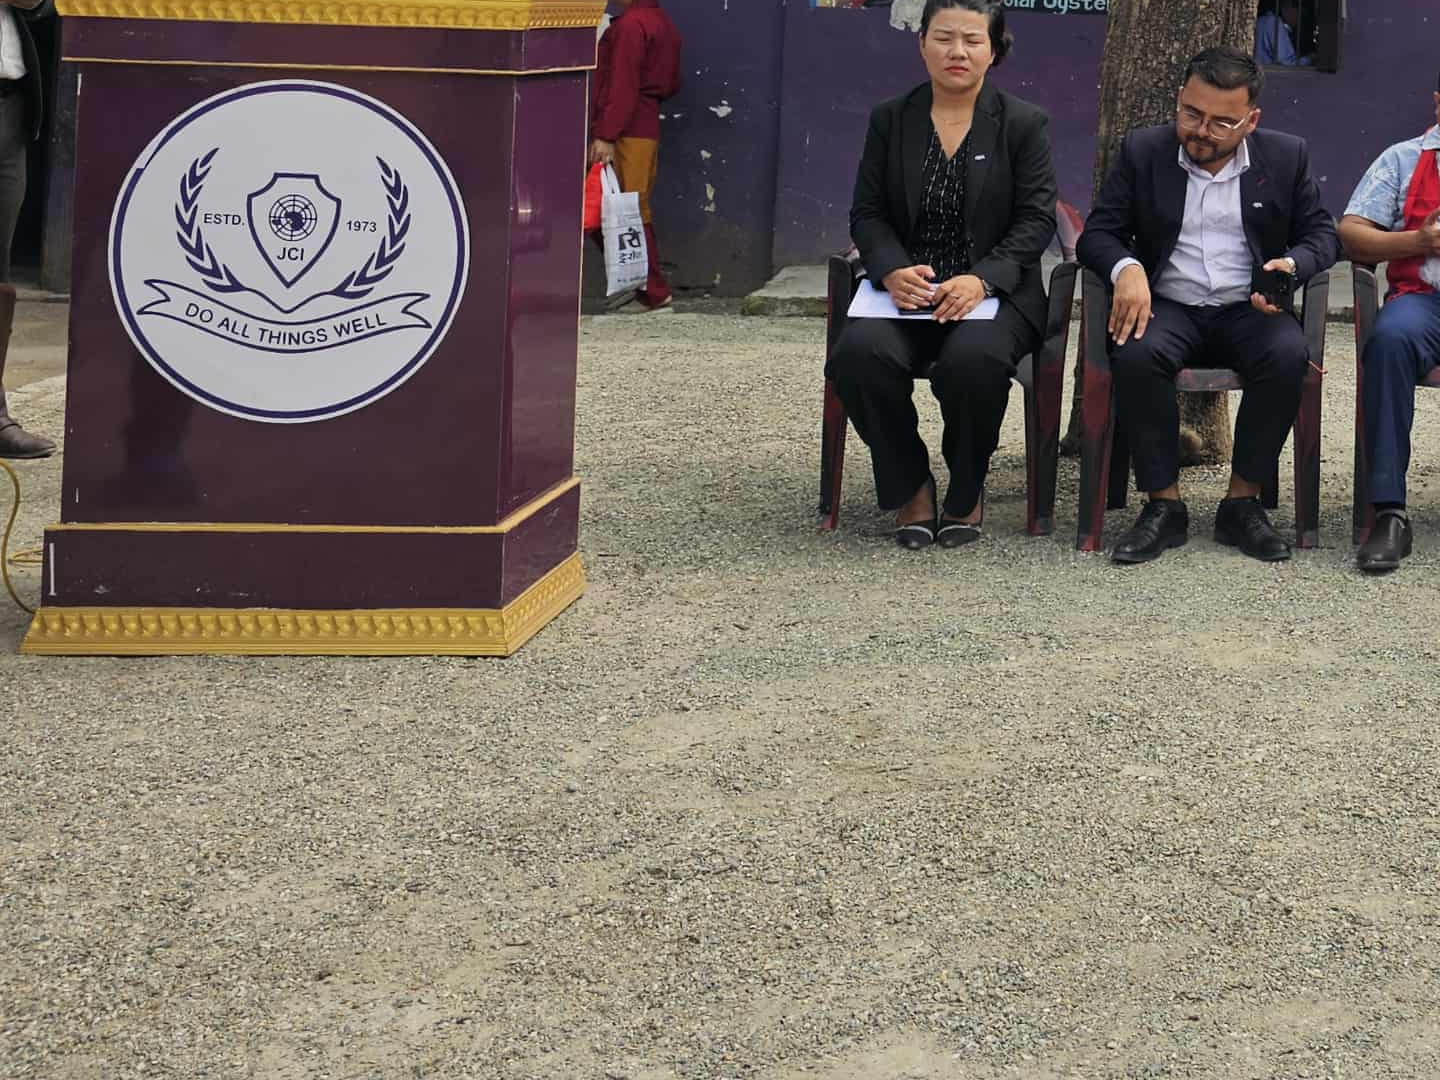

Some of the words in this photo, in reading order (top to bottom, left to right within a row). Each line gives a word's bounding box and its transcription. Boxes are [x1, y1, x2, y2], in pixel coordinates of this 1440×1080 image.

[204, 213, 245, 227] ESTD.
[346, 220, 378, 233] 1973
[276, 247, 305, 261] JCI
[185, 302, 213, 323] DO
[217, 317, 250, 339] ALL
[258, 327, 329, 346] THINGS
[332, 312, 388, 338] WELL
